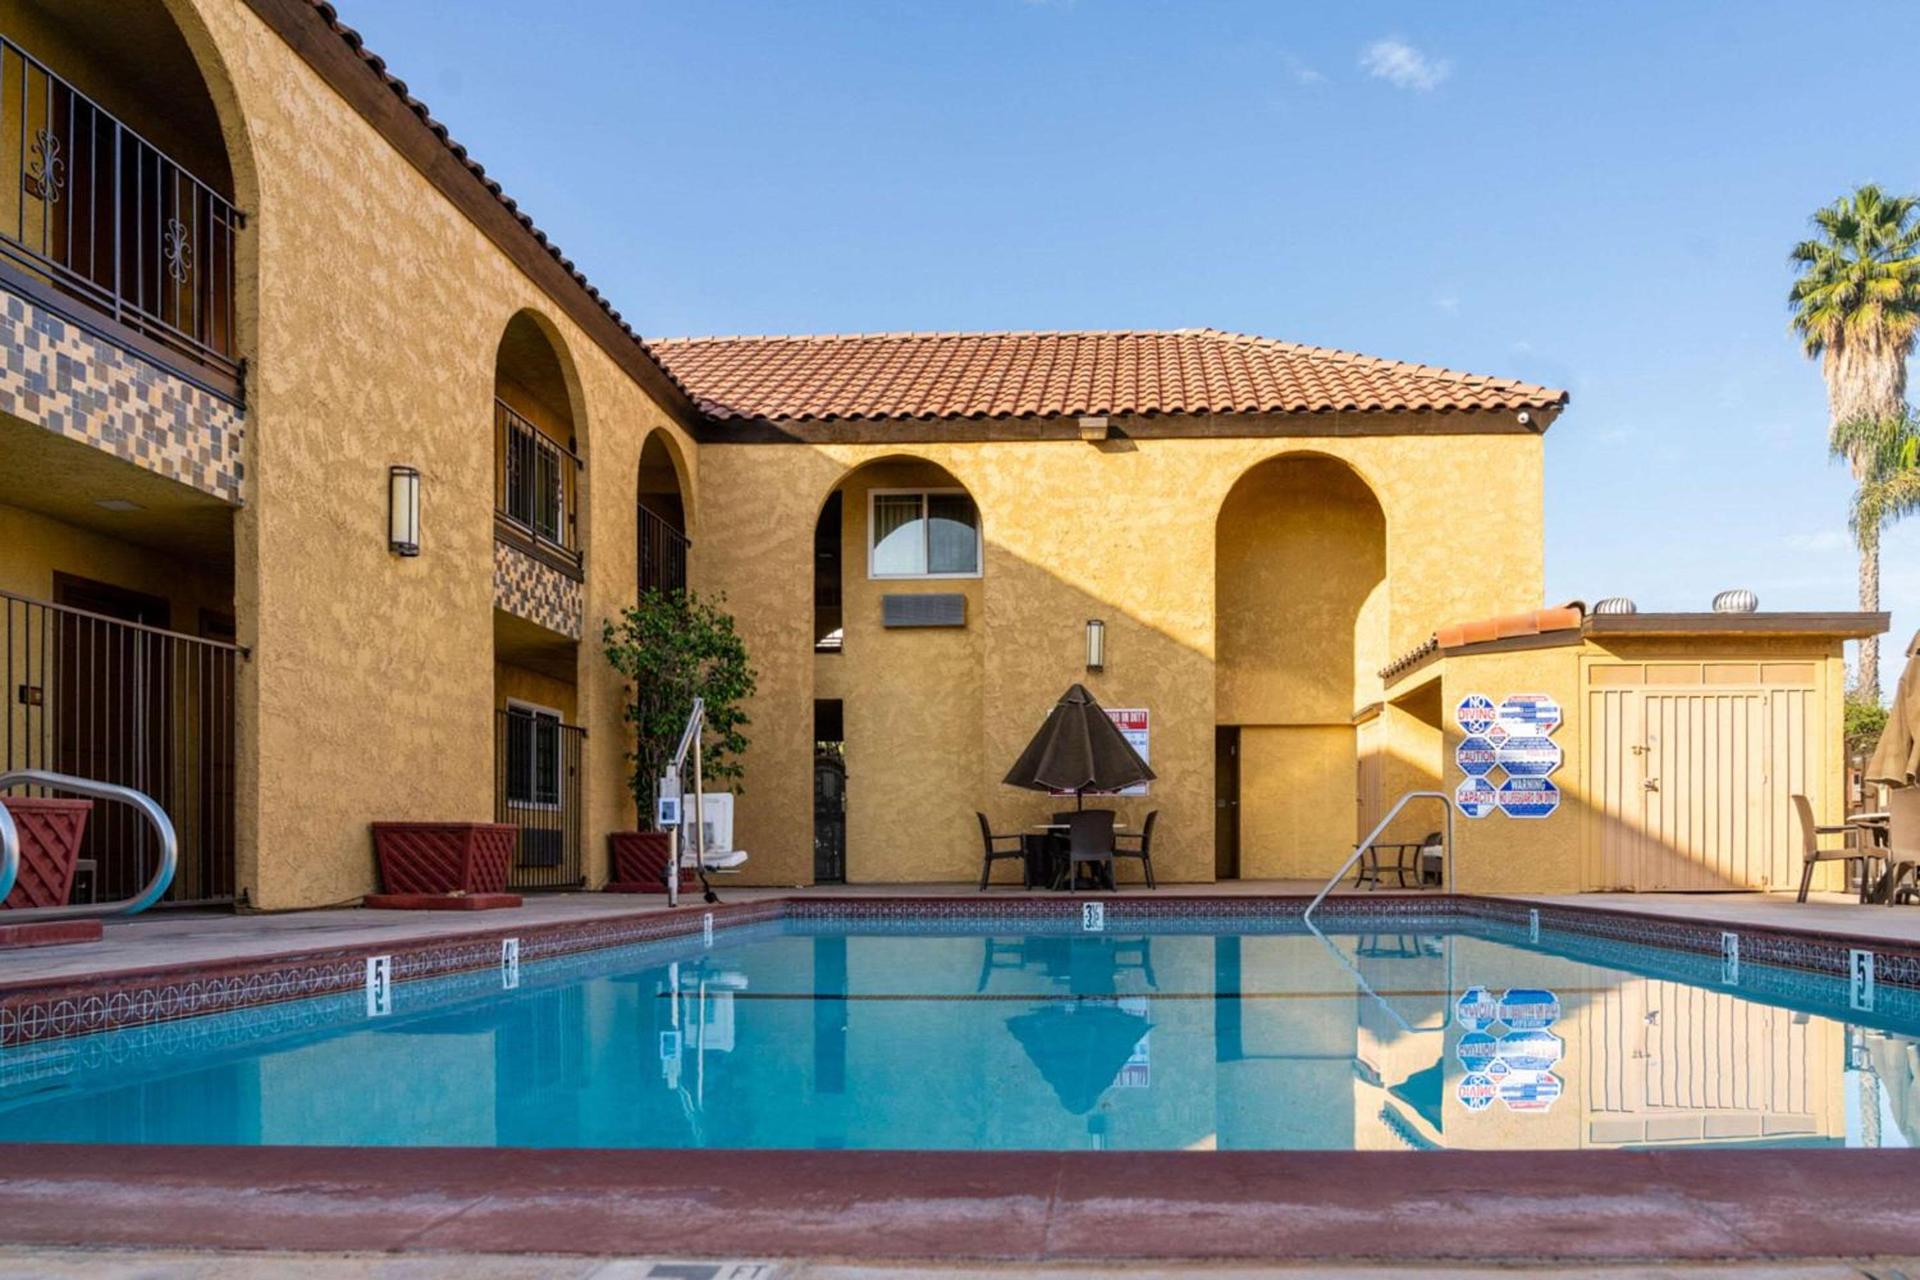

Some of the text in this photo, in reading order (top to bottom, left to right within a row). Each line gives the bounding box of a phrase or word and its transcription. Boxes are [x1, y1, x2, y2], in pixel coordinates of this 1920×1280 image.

[1470, 695, 1486, 708] NO
[1458, 708, 1496, 720] DIVING
[1458, 750, 1496, 763] CAUTION
[1511, 778, 1546, 791] WARNING
[1458, 790, 1496, 804] CAPACITY
